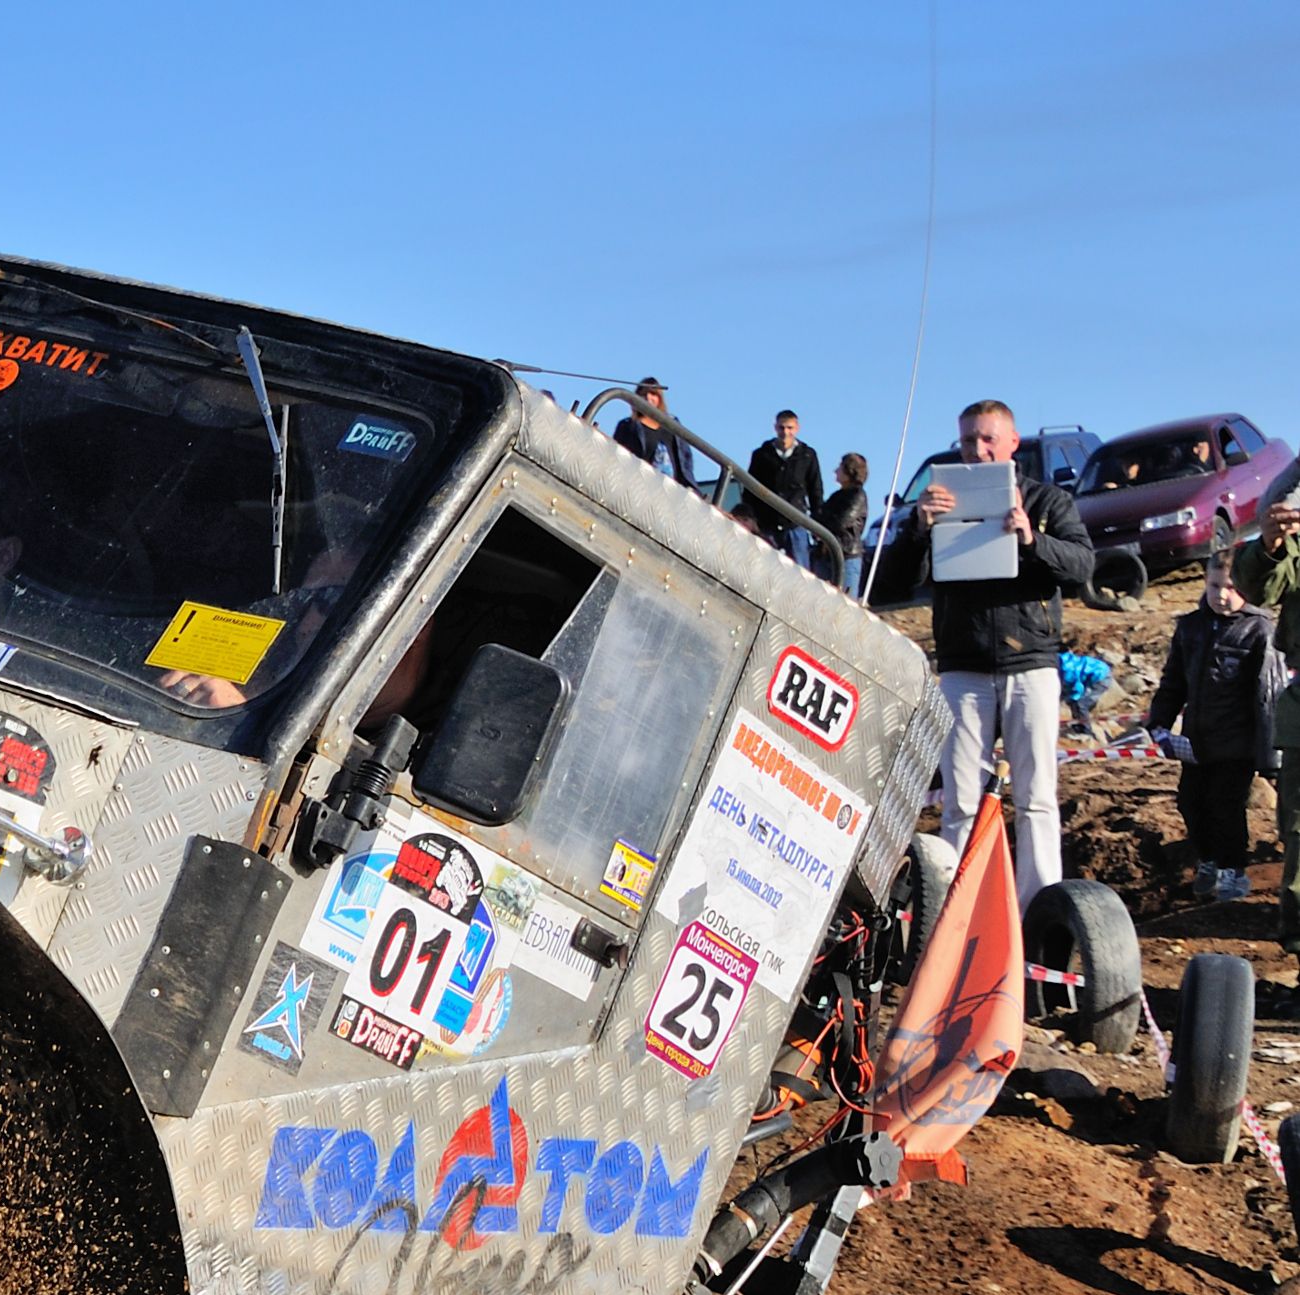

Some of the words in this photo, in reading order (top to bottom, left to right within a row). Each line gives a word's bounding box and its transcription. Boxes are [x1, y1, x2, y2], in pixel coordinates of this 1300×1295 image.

[776, 661, 849, 735] RAF
[732, 722, 828, 813] ВНЕДОРОЖНОЕ
[708, 785, 747, 828] ДЕНЬ
[748, 813, 835, 893] МЕТАЛЛУРГА
[760, 883, 783, 910] 2012
[369, 907, 452, 1016] 01
[686, 924, 752, 982] Мончегорск
[660, 962, 734, 1051] 25
